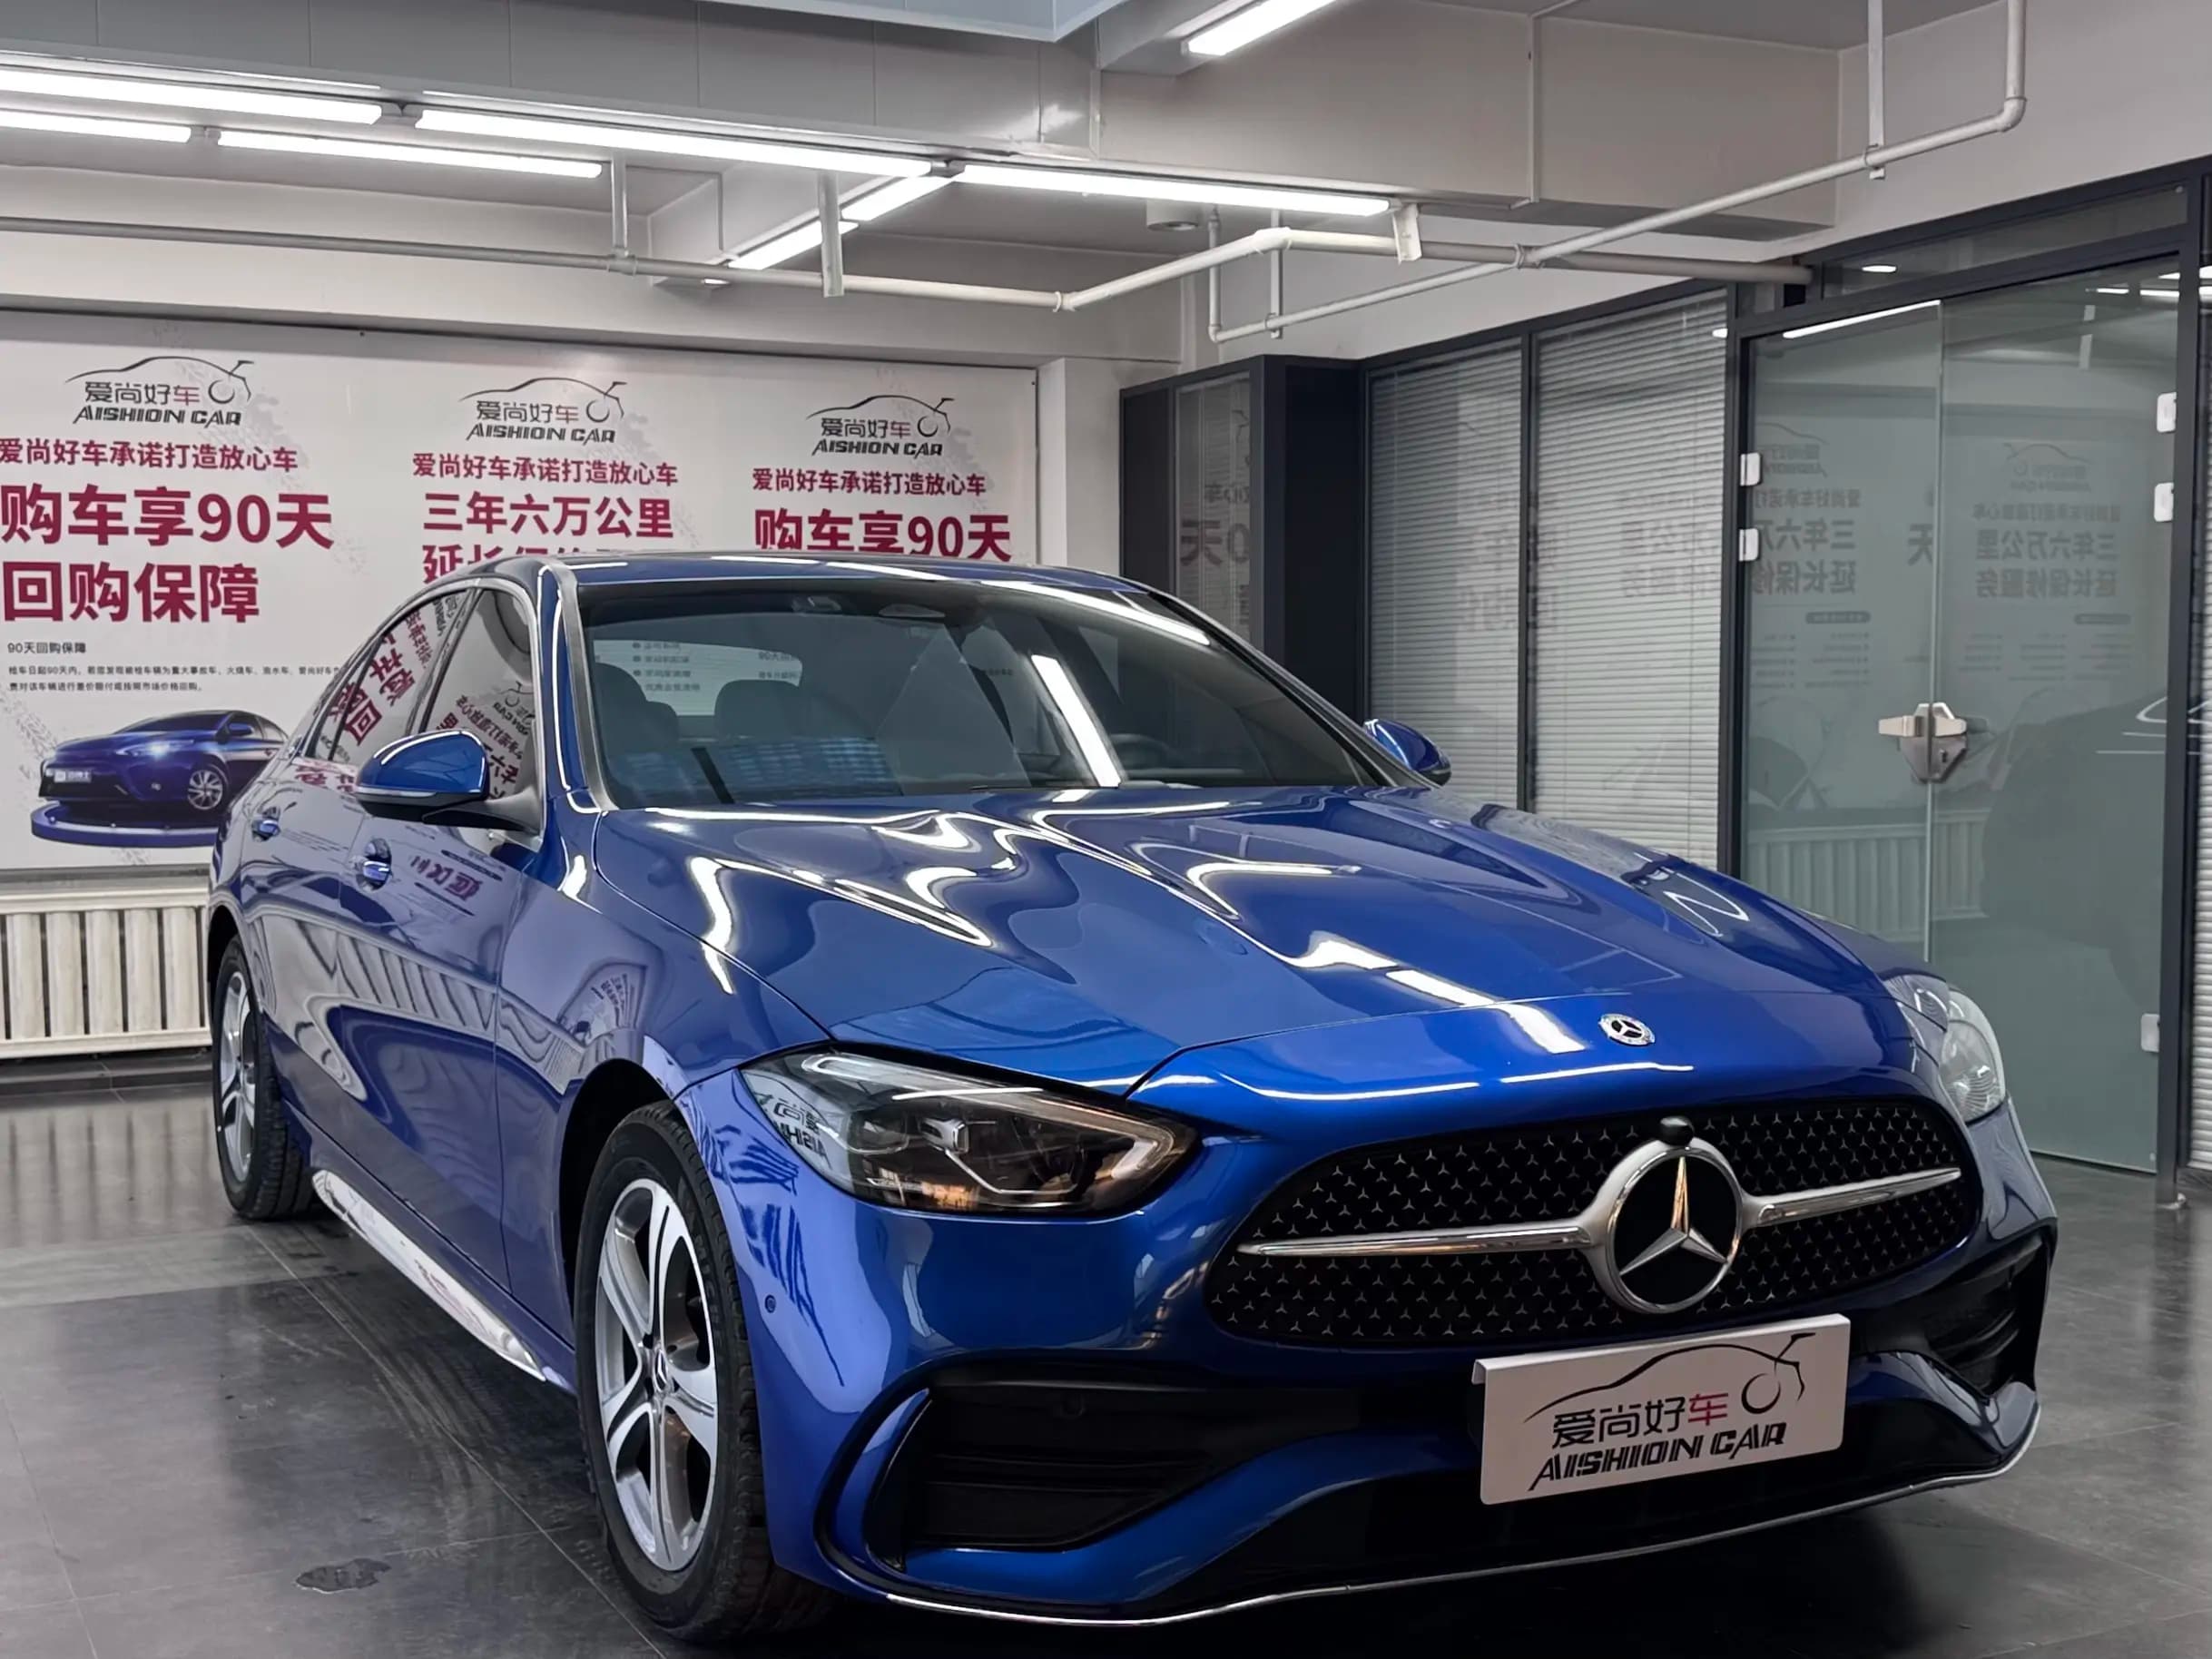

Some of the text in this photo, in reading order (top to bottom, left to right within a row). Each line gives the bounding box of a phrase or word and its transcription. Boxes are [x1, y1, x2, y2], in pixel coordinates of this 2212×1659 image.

[85, 381, 200, 407] 爱尚好车
[73, 406, 241, 428] AISHION CAR
[477, 399, 579, 425] 爱尚好车
[466, 422, 616, 446] AISHION CAR
[821, 417, 911, 439] 爱尚好车
[0, 437, 299, 473] 爱尚好车承诺打造放心车
[811, 439, 943, 459] AISHION CAR
[412, 453, 678, 486] 爱尚好车承诺打造放心车
[752, 467, 987, 497] 爱尚好车承诺打造放心车
[1, 482, 334, 550] 购车享90天
[423, 491, 673, 538] 三年六万公里
[754, 508, 1012, 563] 购车享90天
[3, 561, 261, 623] 回购保障
[7, 642, 86, 654] 90天回购保障
[1551, 1392, 1729, 1450] 爱尚好车
[1528, 1422, 1788, 1492] AISHION CAR
